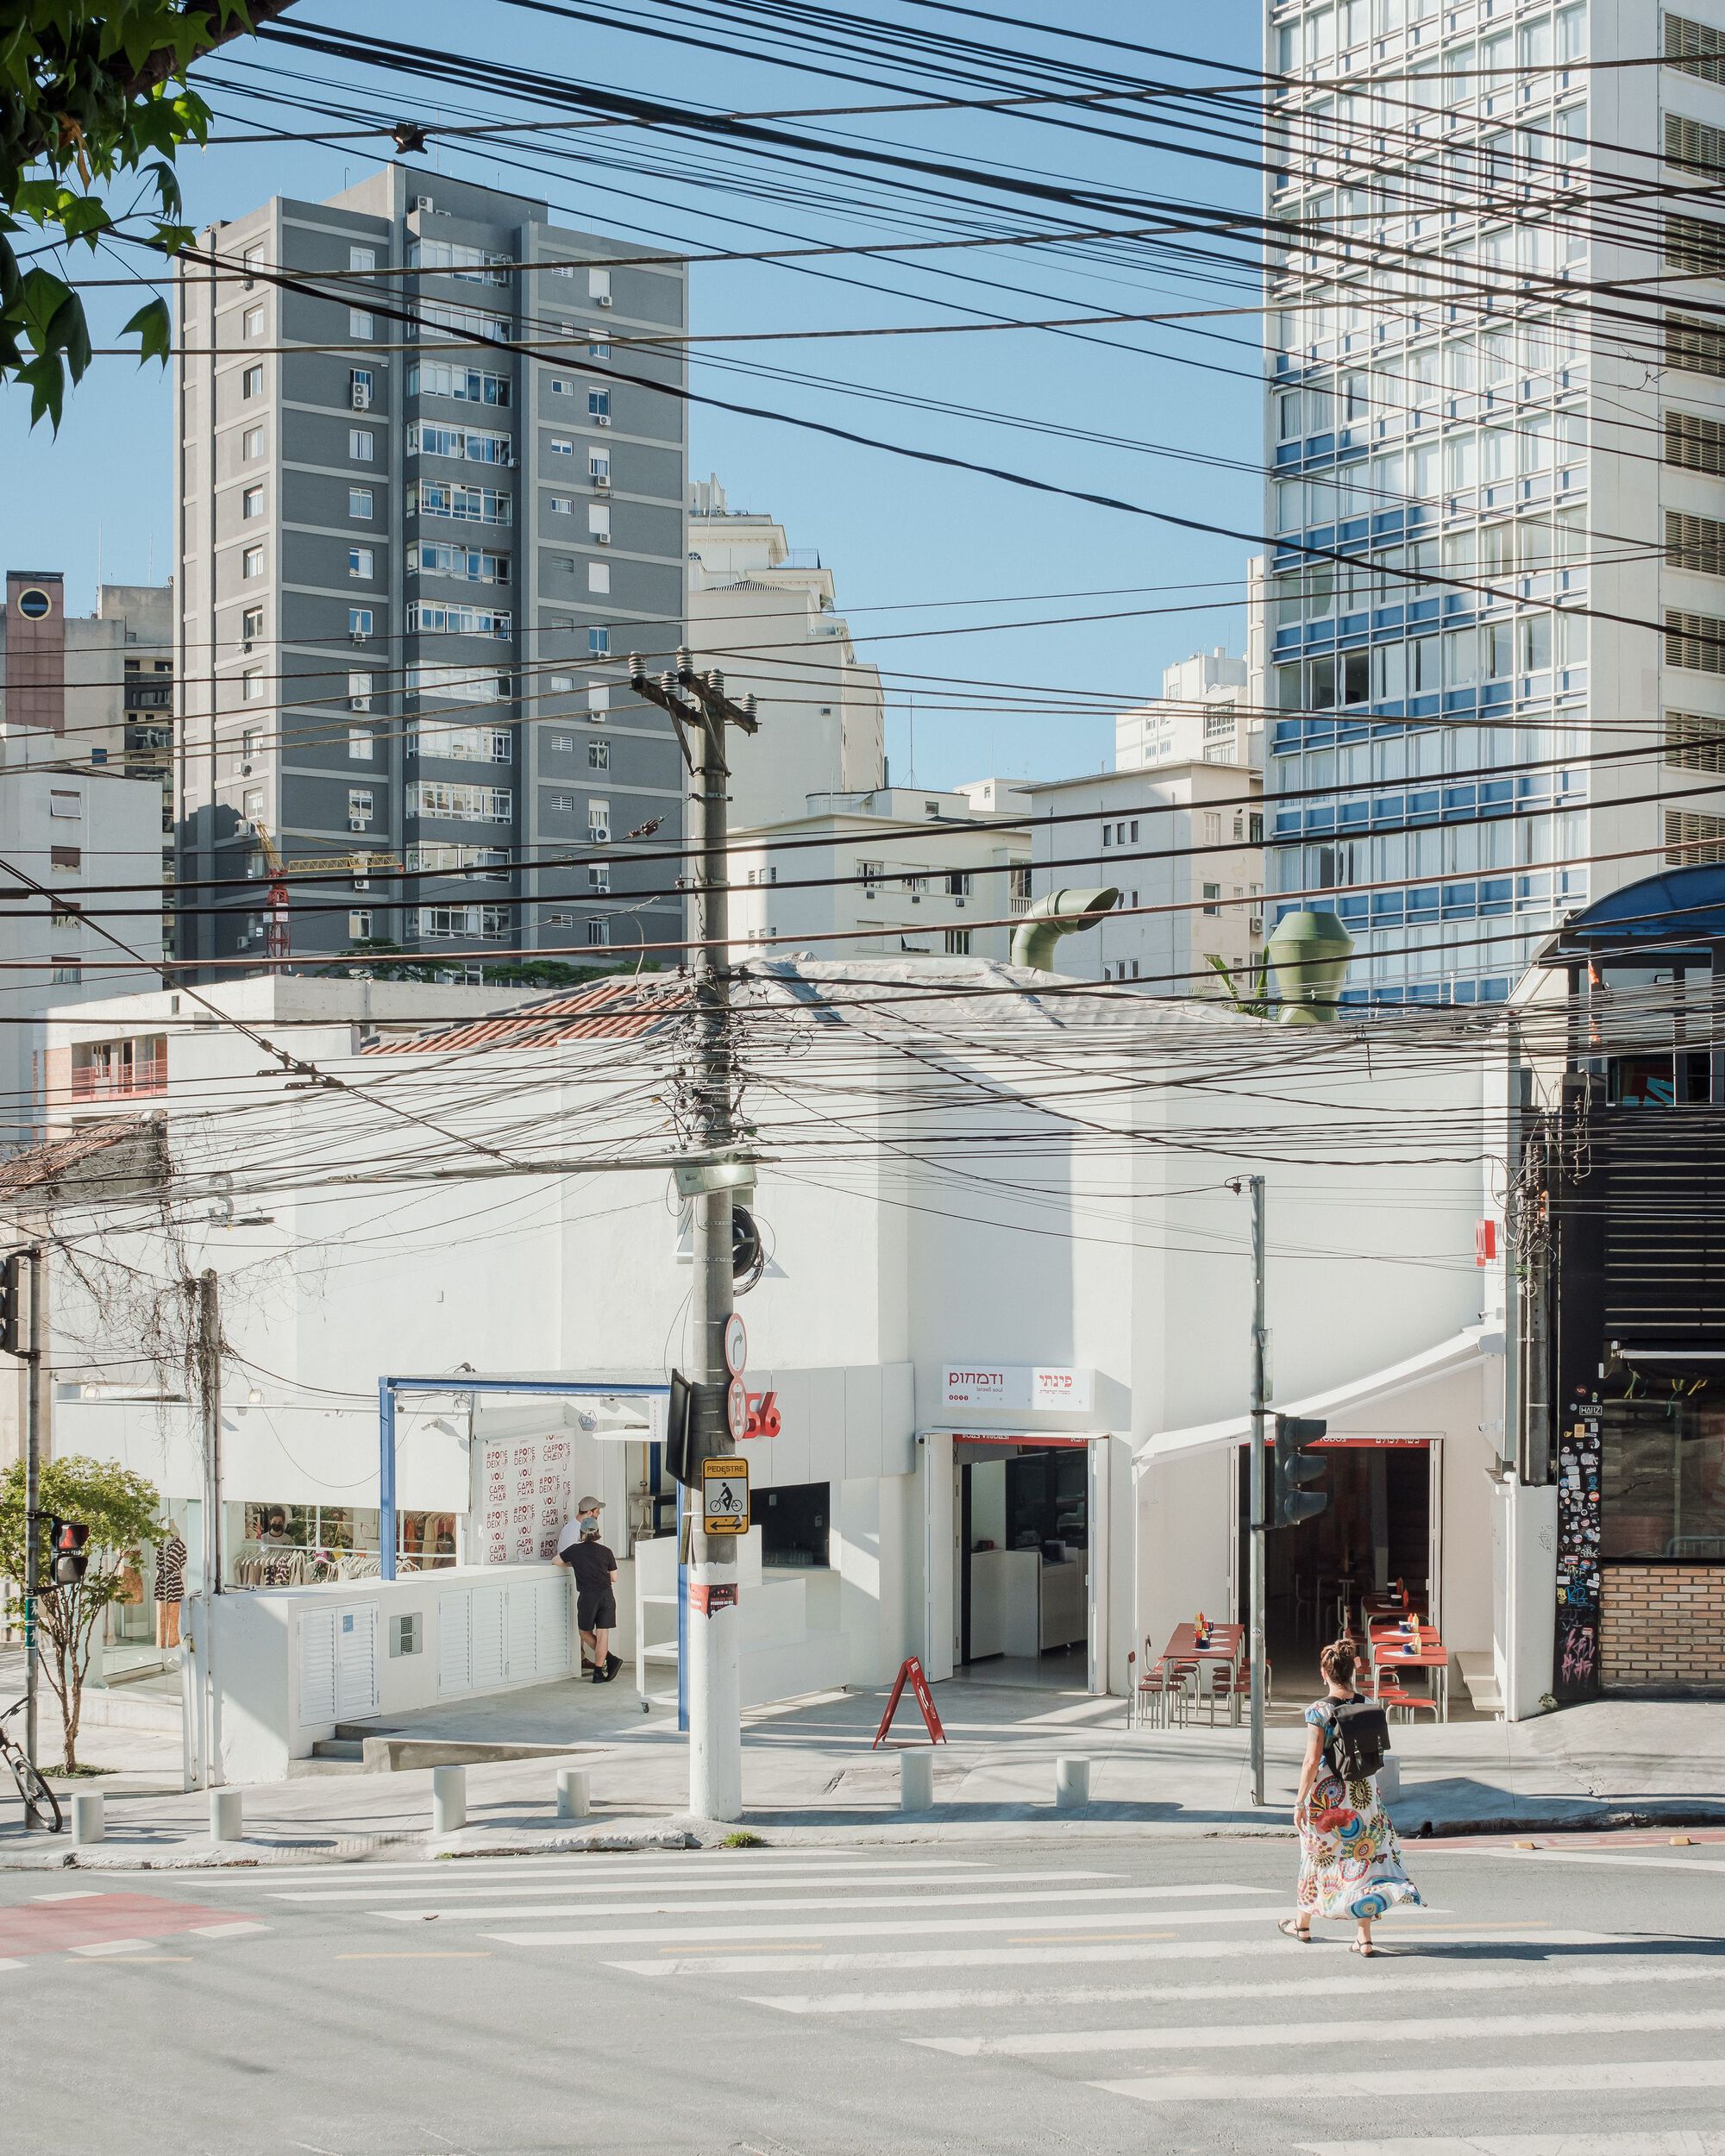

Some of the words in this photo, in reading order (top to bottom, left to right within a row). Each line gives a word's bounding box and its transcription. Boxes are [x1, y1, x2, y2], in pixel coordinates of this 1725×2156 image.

[1038, 1375, 1073, 1388] פינתי
[491, 1471, 505, 1481] VOU
[518, 1468, 532, 1477] VOU
[543, 1496, 557, 1505] VOU
[518, 1526, 531, 1534] VOU
[491, 1532, 505, 1541] VOU
[540, 1539, 559, 1549] #POD
